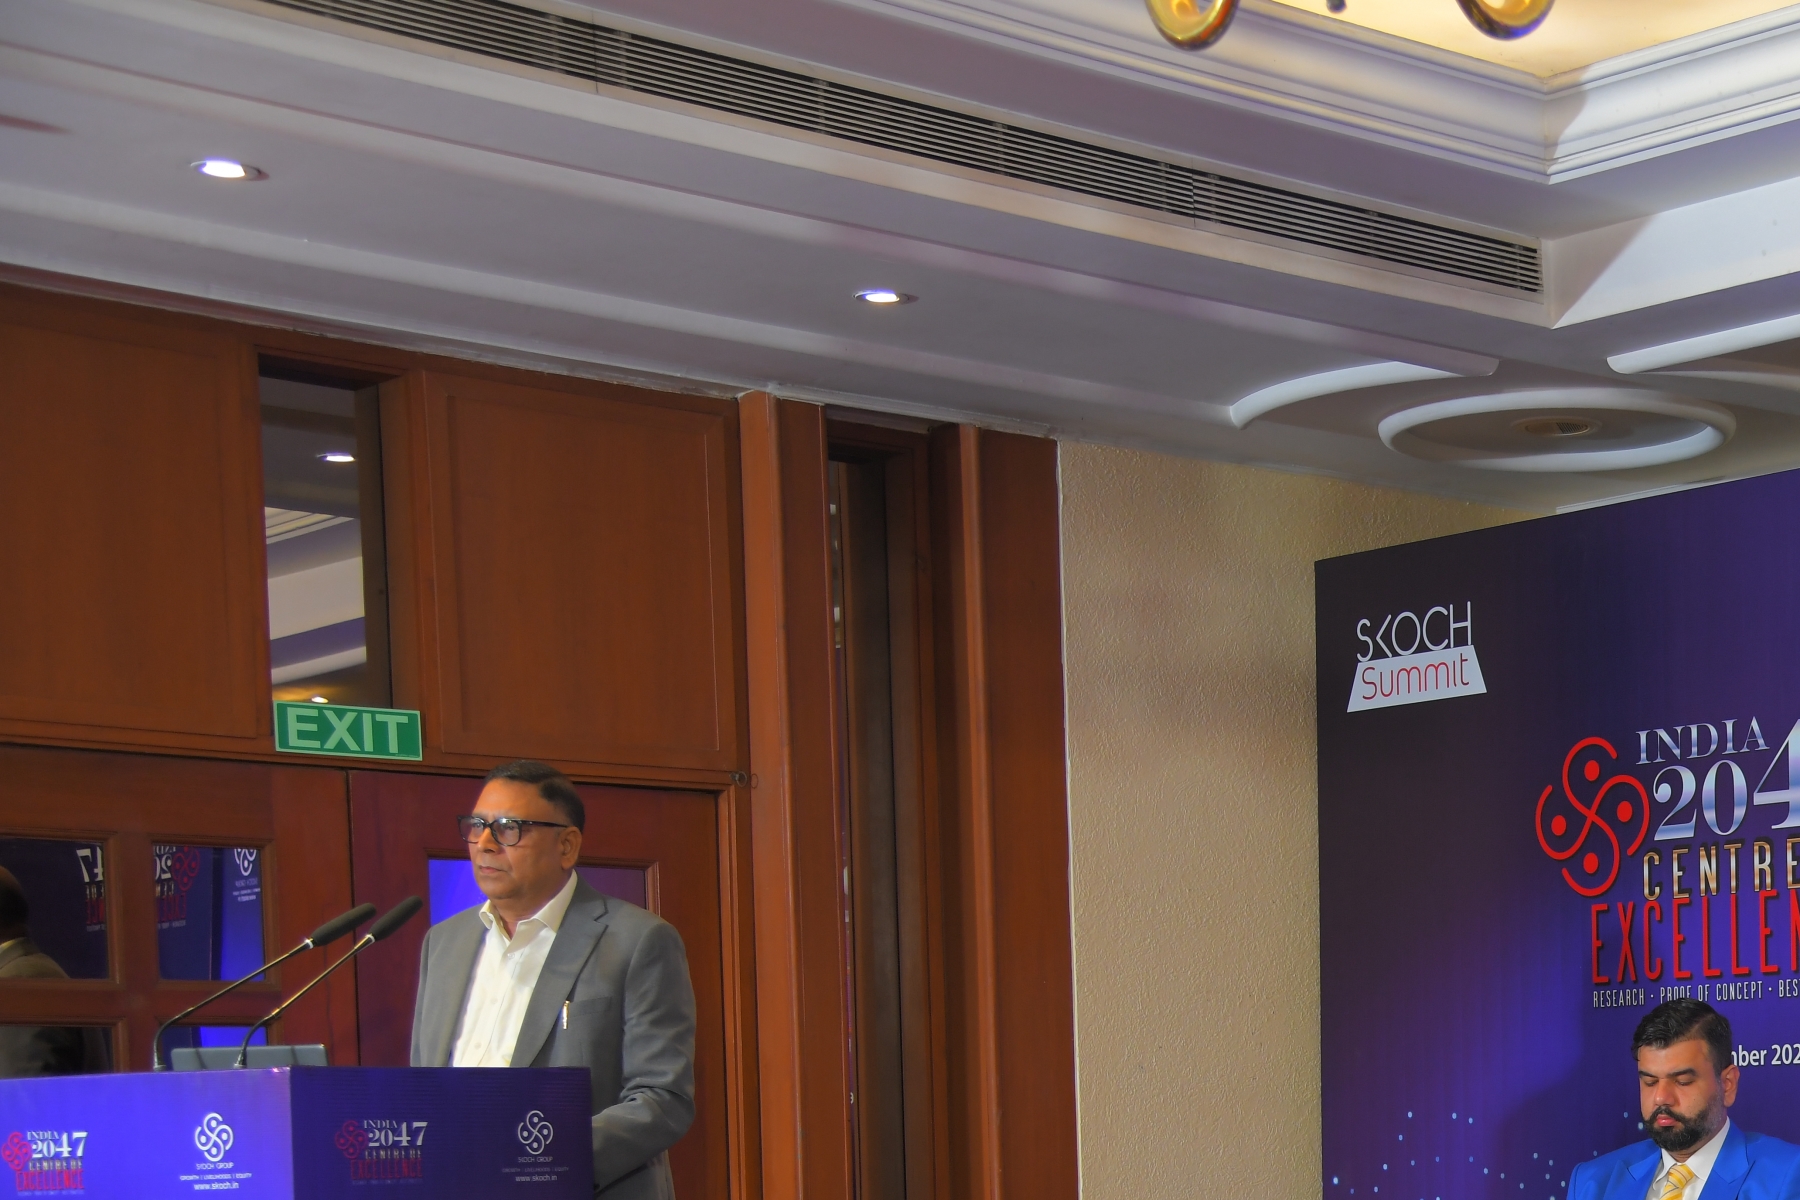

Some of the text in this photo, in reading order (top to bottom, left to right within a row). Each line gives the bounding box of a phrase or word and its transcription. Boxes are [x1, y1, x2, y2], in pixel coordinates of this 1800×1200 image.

[1356, 600, 1472, 662] SKOCH
[1361, 653, 1470, 700] Summit
[286, 706, 409, 754] EXIT
[1635, 715, 1771, 765] INDIA
[1593, 987, 1645, 1008] RESEARCH
[1698, 984, 1710, 1002] OF
[1716, 980, 1763, 1001] CONCEPT
[364, 1120, 398, 1129] INDIA
[368, 1121, 429, 1147] 2047
[32, 1131, 88, 1158] 2047
[193, 1182, 240, 1190] www.skoch.in
[515, 1174, 558, 1182] www.skoch.in
